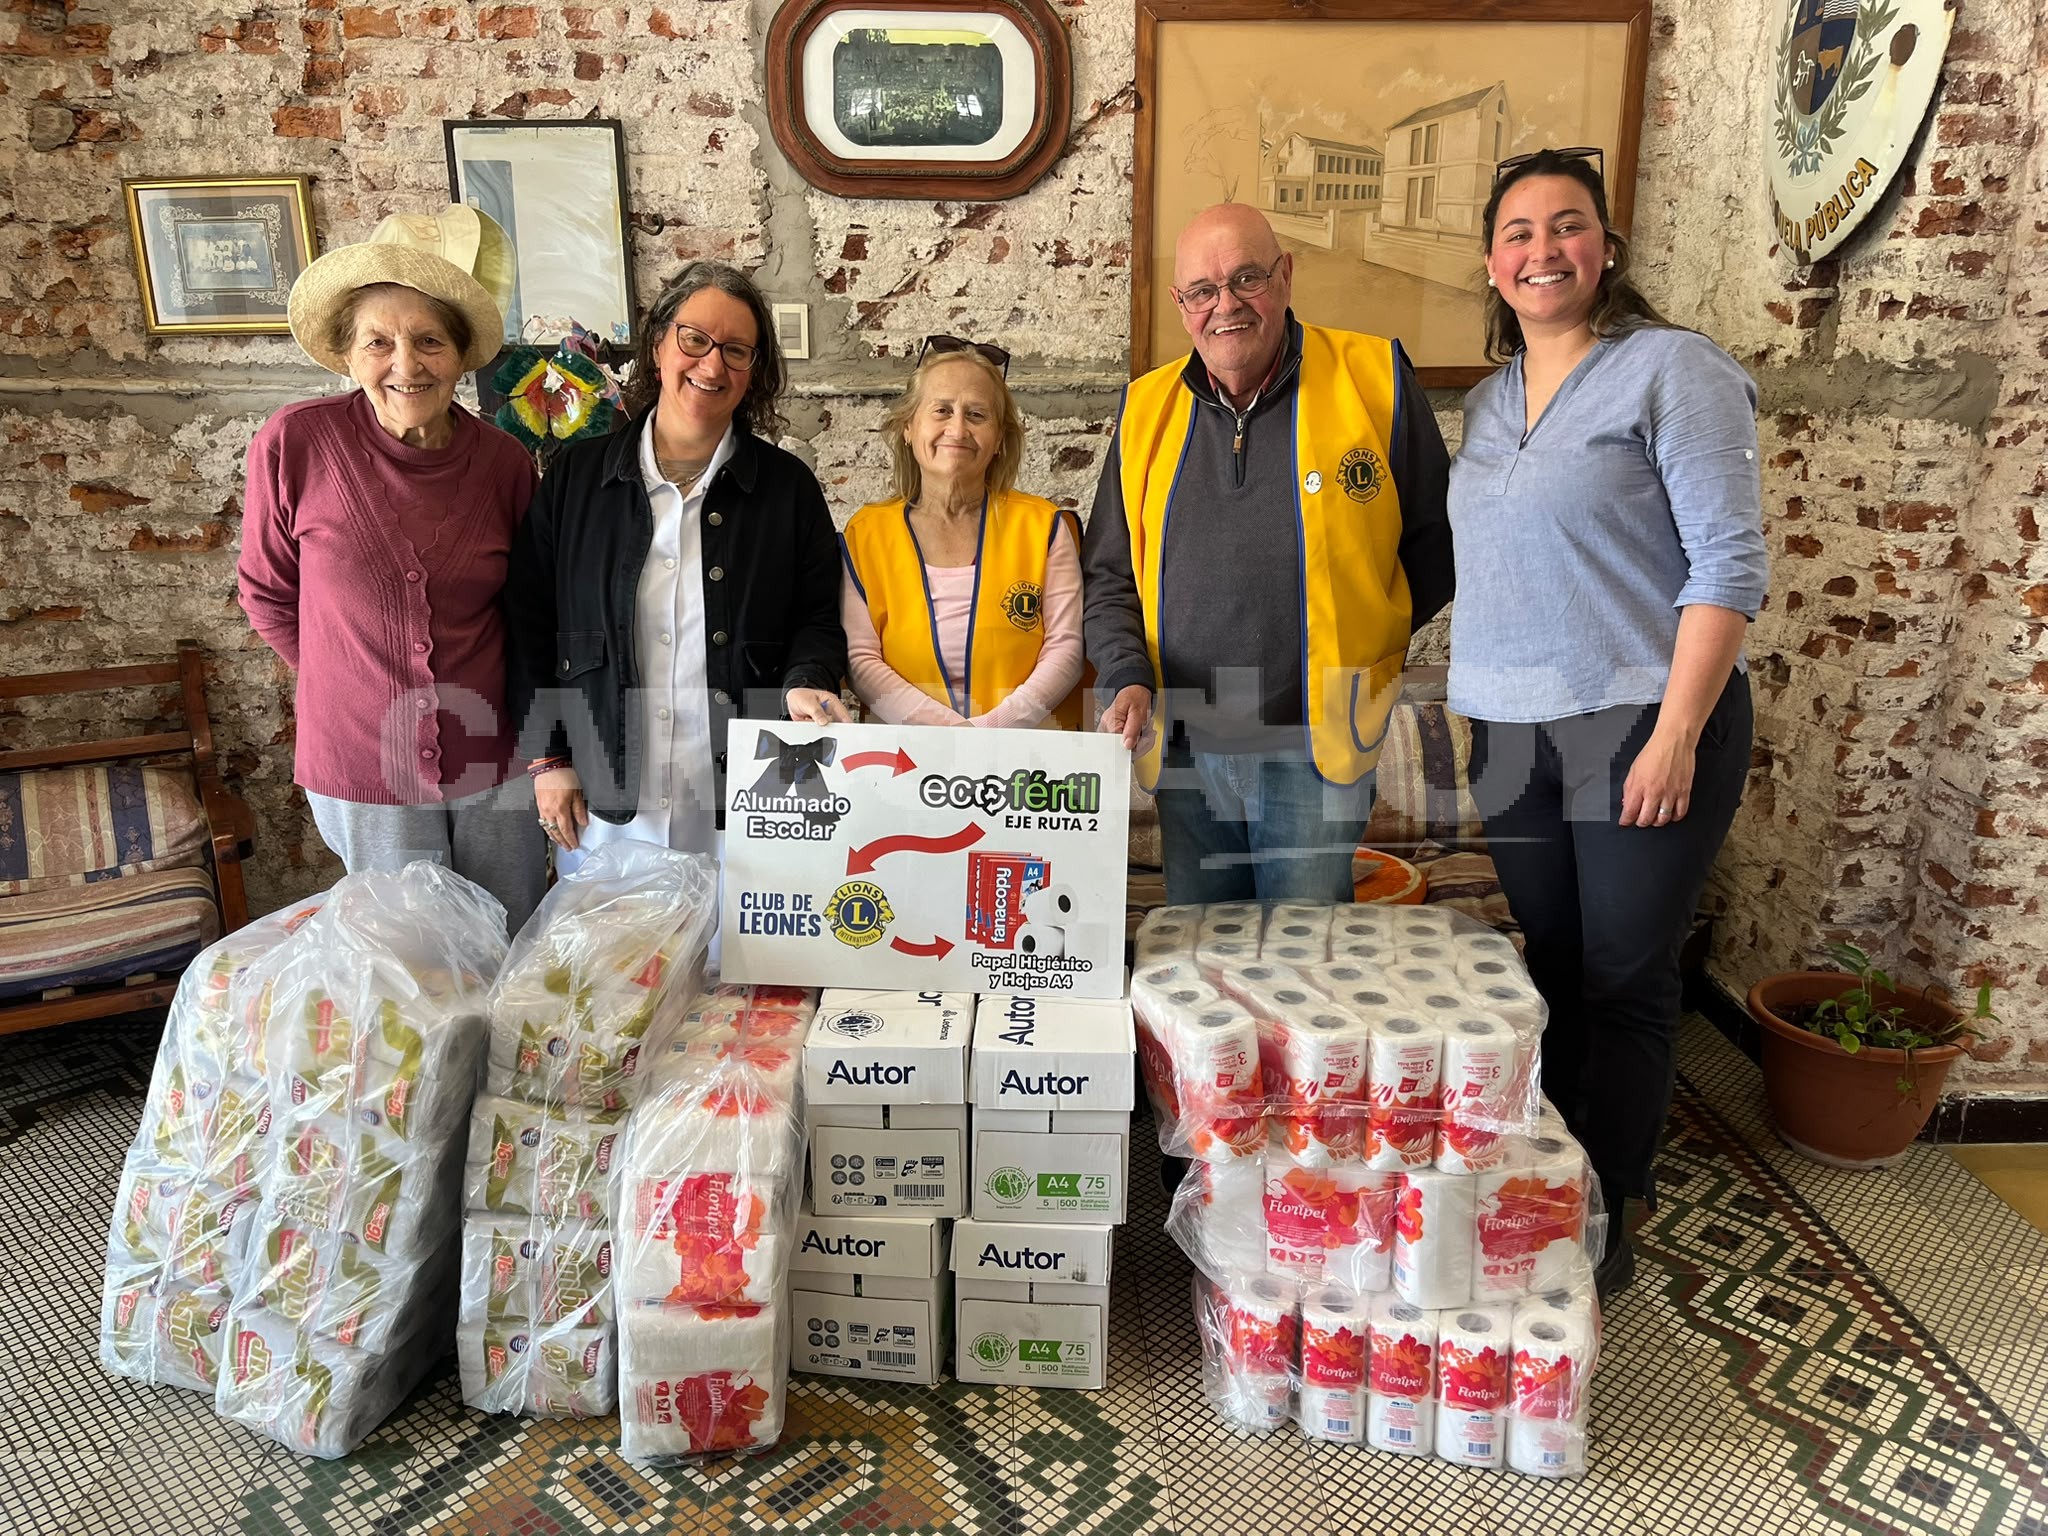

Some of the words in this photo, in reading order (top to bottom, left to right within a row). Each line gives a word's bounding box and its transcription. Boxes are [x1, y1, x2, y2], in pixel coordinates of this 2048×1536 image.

[1805, 157, 1879, 249] PÚBLICA
[1345, 451, 1375, 463] LIONS
[1355, 466, 1368, 485] L
[1012, 583, 1040, 595] LIONS
[1022, 596, 1033, 614] L
[732, 789, 851, 816] Alumnado
[746, 816, 837, 841] Escolar
[1005, 815, 1032, 829] EJE
[1038, 816, 1083, 831] RUTA
[1088, 818, 1098, 832] 2
[1027, 867, 1039, 877] A4
[839, 884, 880, 899] LIONS
[741, 892, 785, 911] CLUB
[792, 893, 812, 912] DE
[991, 867, 1012, 944] fanacopy
[851, 902, 869, 926] L
[739, 911, 821, 937] LEONES
[838, 930, 879, 945] INTERNATIONAL
[972, 953, 1016, 972] Papel
[1018, 954, 1092, 974] Higiénico
[989, 975, 1000, 989] y
[1003, 972, 1048, 990] Hojas
[1050, 974, 1073, 989] A4
[1238, 1052, 1247, 1065] 3
[1352, 1055, 1359, 1068] 3
[1426, 1059, 1434, 1072] 3
[827, 1061, 915, 1084] Autor
[1492, 1066, 1500, 1079] 3
[1000, 1070, 1088, 1094] Autor
[388, 1099, 403, 1117] 16
[497, 1143, 513, 1160] 16
[1046, 1176, 1069, 1189] A4
[1085, 1177, 1105, 1190] 75
[707, 1179, 724, 1241] Floripel
[1043, 1199, 1049, 1207] 5
[1269, 1199, 1327, 1221] Floripel
[1484, 1212, 1537, 1233] Floripel
[365, 1223, 382, 1243] 16
[801, 1230, 885, 1257] Autor
[601, 1248, 609, 1274] NUEVO
[978, 1244, 1065, 1269] Autor
[1028, 1342, 1051, 1354] A4
[1066, 1344, 1085, 1356] 75
[586, 1346, 597, 1376] NUEVO
[1041, 1364, 1058, 1372] 500
[1317, 1364, 1358, 1379] Floripel
[1380, 1373, 1423, 1387] Floripel
